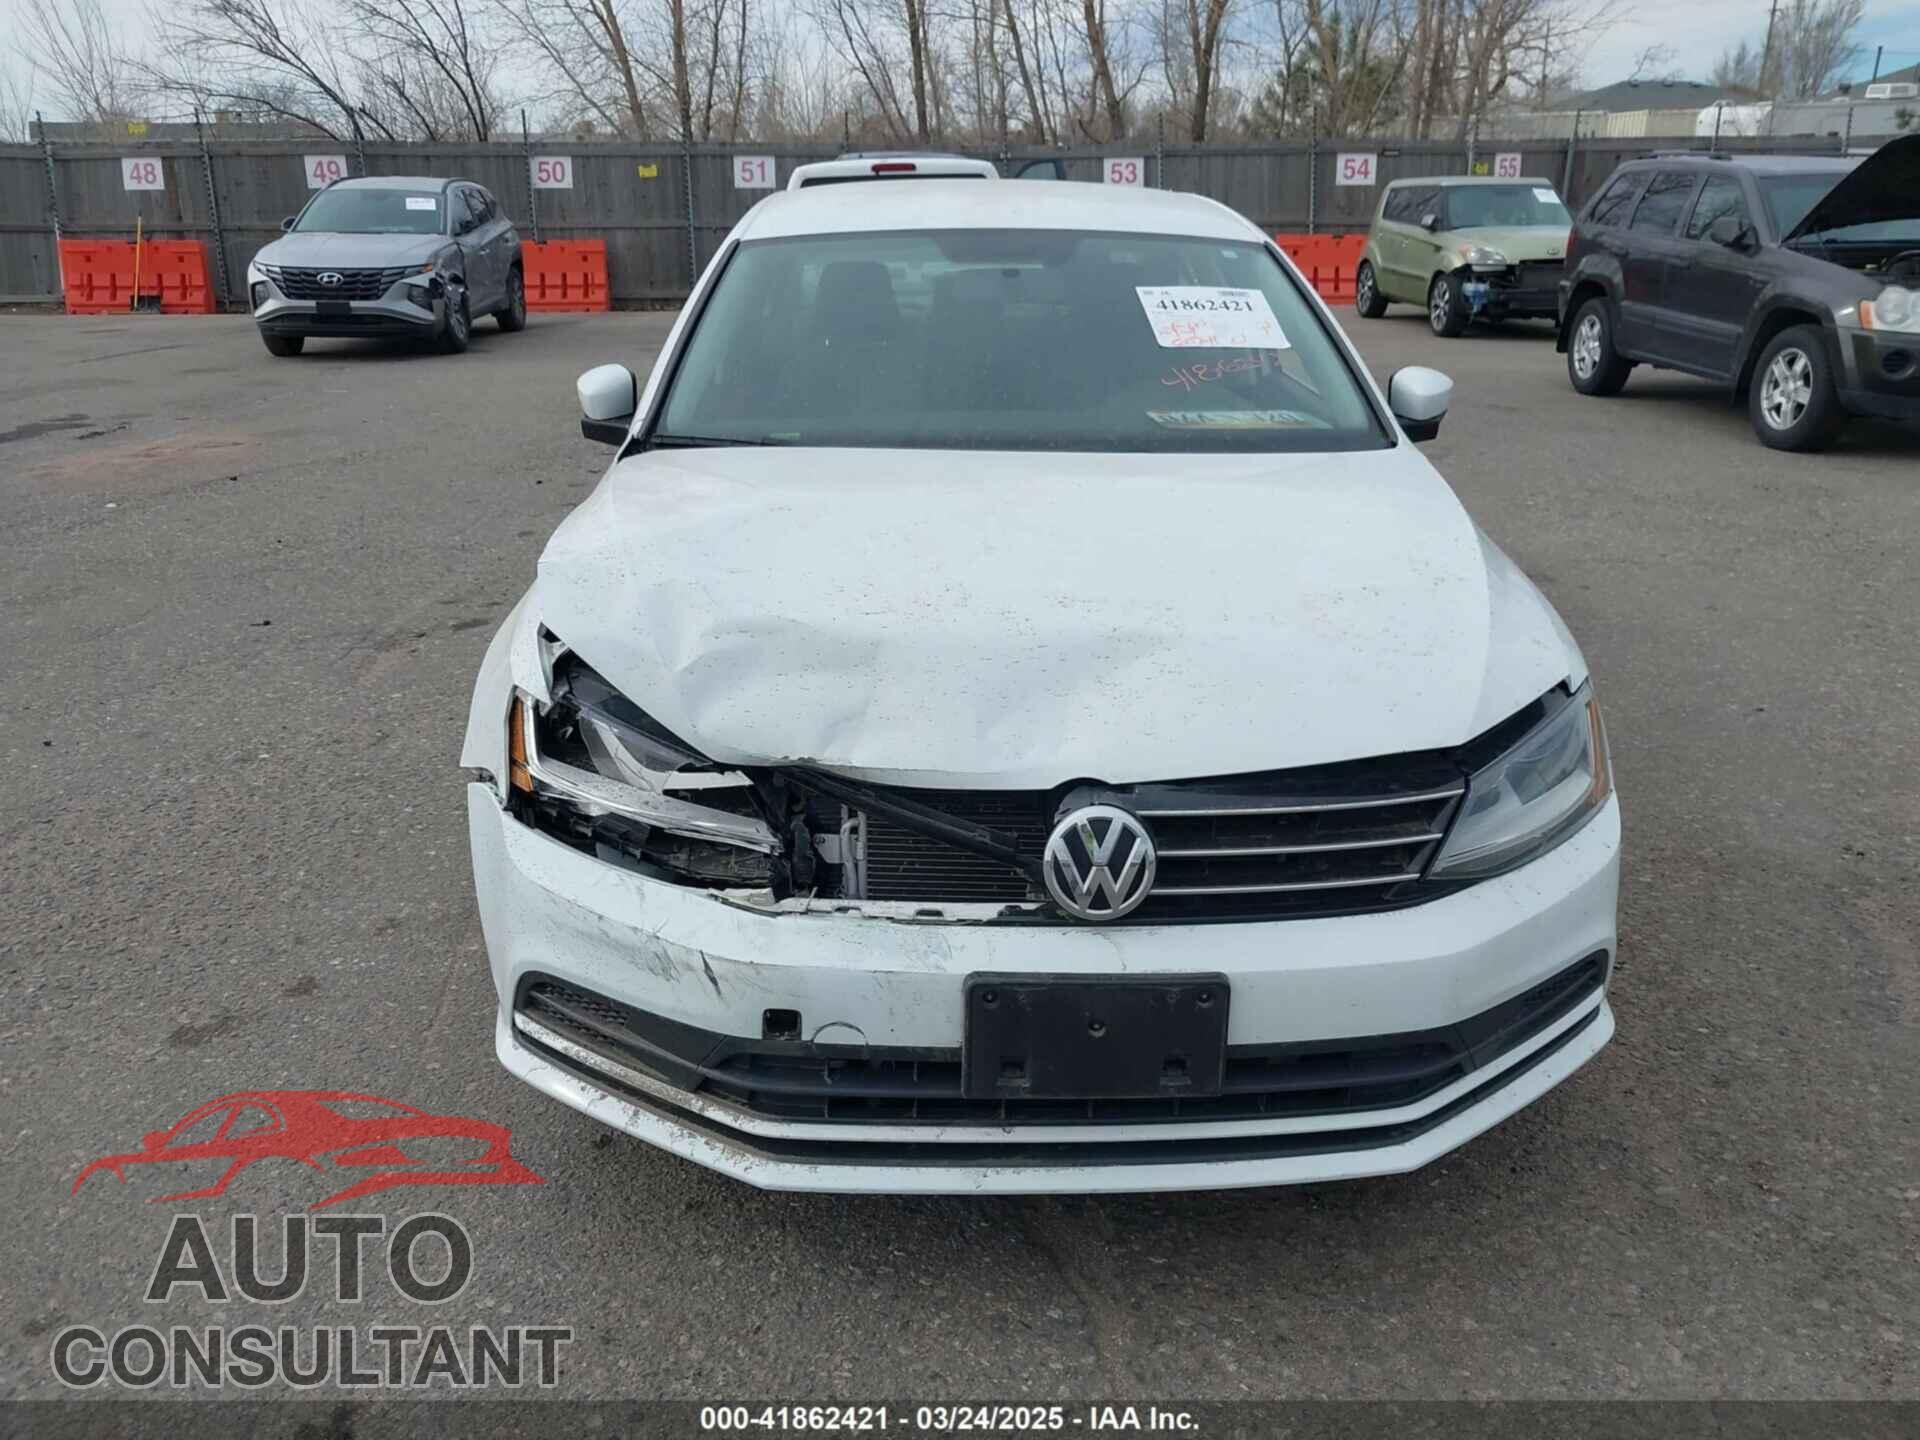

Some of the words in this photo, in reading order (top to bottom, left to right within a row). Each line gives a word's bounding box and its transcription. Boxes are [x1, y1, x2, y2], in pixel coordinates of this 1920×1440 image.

[129, 162, 157, 185] 48
[313, 160, 341, 183] 49
[537, 160, 565, 183] 50
[741, 160, 767, 183] 51
[1110, 162, 1138, 184] 53
[1343, 158, 1371, 180] 54
[1499, 157, 1518, 177] 55
[1155, 298, 1254, 313] 41862421
